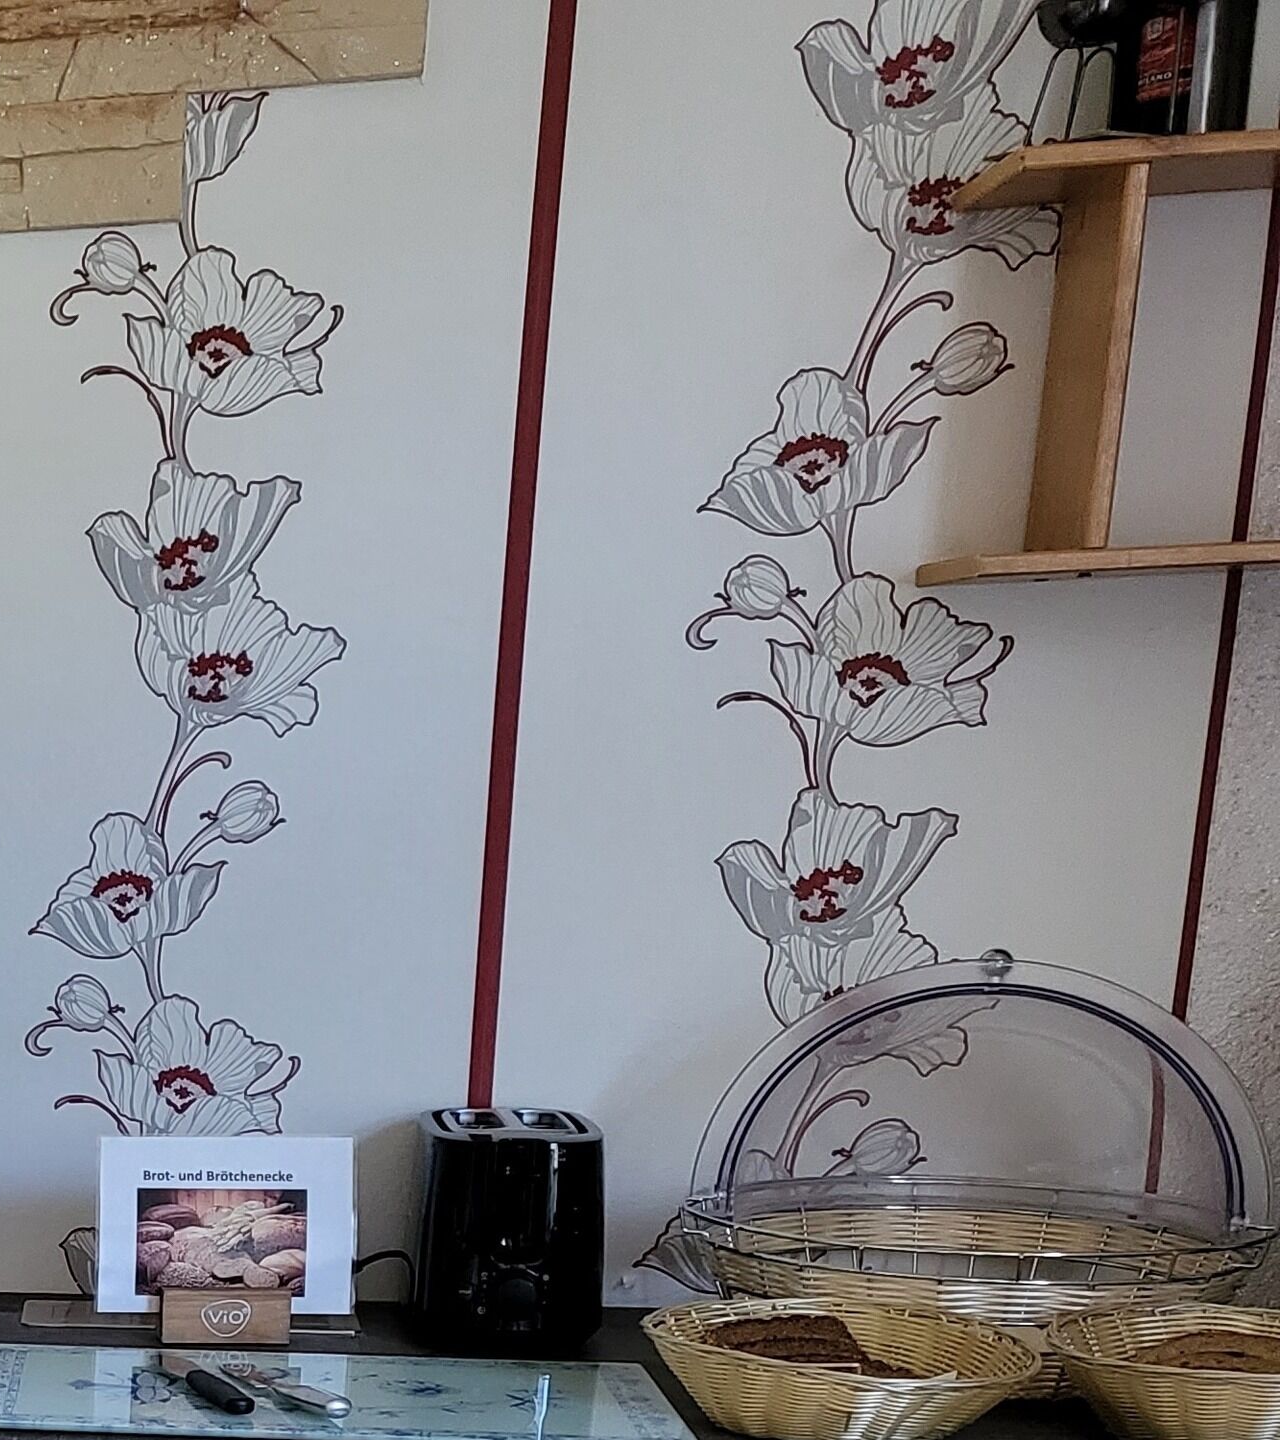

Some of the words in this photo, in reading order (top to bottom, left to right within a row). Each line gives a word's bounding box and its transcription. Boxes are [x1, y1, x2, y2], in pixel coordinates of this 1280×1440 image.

[143, 1169, 175, 1181] Brot-
[178, 1169, 203, 1181] und
[206, 1169, 294, 1182] Brötchenecke
